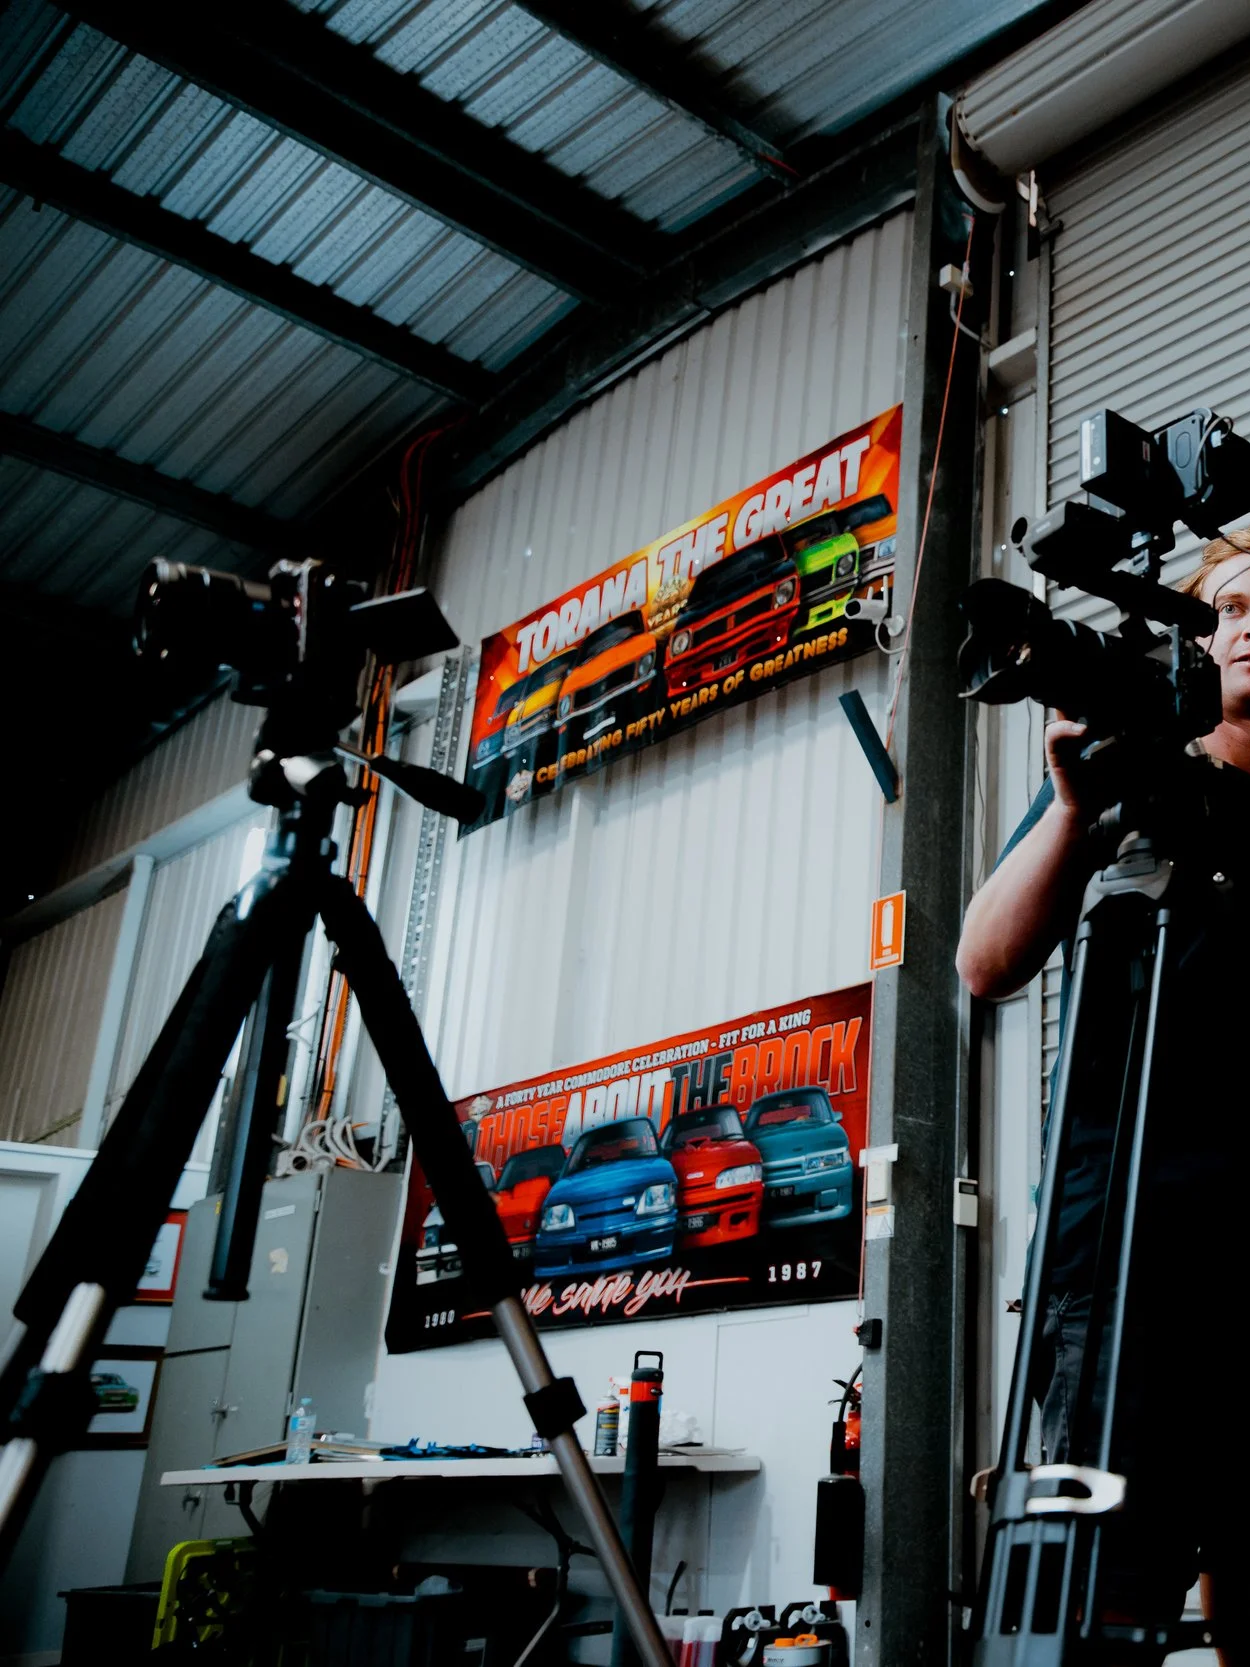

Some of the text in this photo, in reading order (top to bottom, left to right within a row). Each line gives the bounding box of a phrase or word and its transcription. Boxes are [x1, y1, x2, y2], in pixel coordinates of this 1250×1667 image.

[516, 434, 871, 674] TORANA THE GREAT
[626, 707, 666, 740] FIFTY
[670, 683, 719, 719] YEARS
[723, 669, 745, 695] OF
[750, 627, 848, 682] GREATNESS
[474, 1096, 567, 1170] THOSE
[561, 1066, 672, 1148] ABOUT
[671, 1050, 734, 1117] THE
[730, 1016, 862, 1104] BROCK
[496, 1096, 505, 1109] A
[505, 1087, 536, 1108] FORTY
[536, 1080, 564, 1098] YEAR
[564, 1062, 632, 1092] COMMODORE
[632, 1038, 710, 1072] CELEBRATION
[718, 1029, 741, 1049] FIT
[741, 1022, 767, 1042] FOR
[766, 1020, 778, 1035] A
[778, 1009, 812, 1032] KING
[624, 1266, 692, 1317] you
[768, 1260, 822, 1282] 1987
